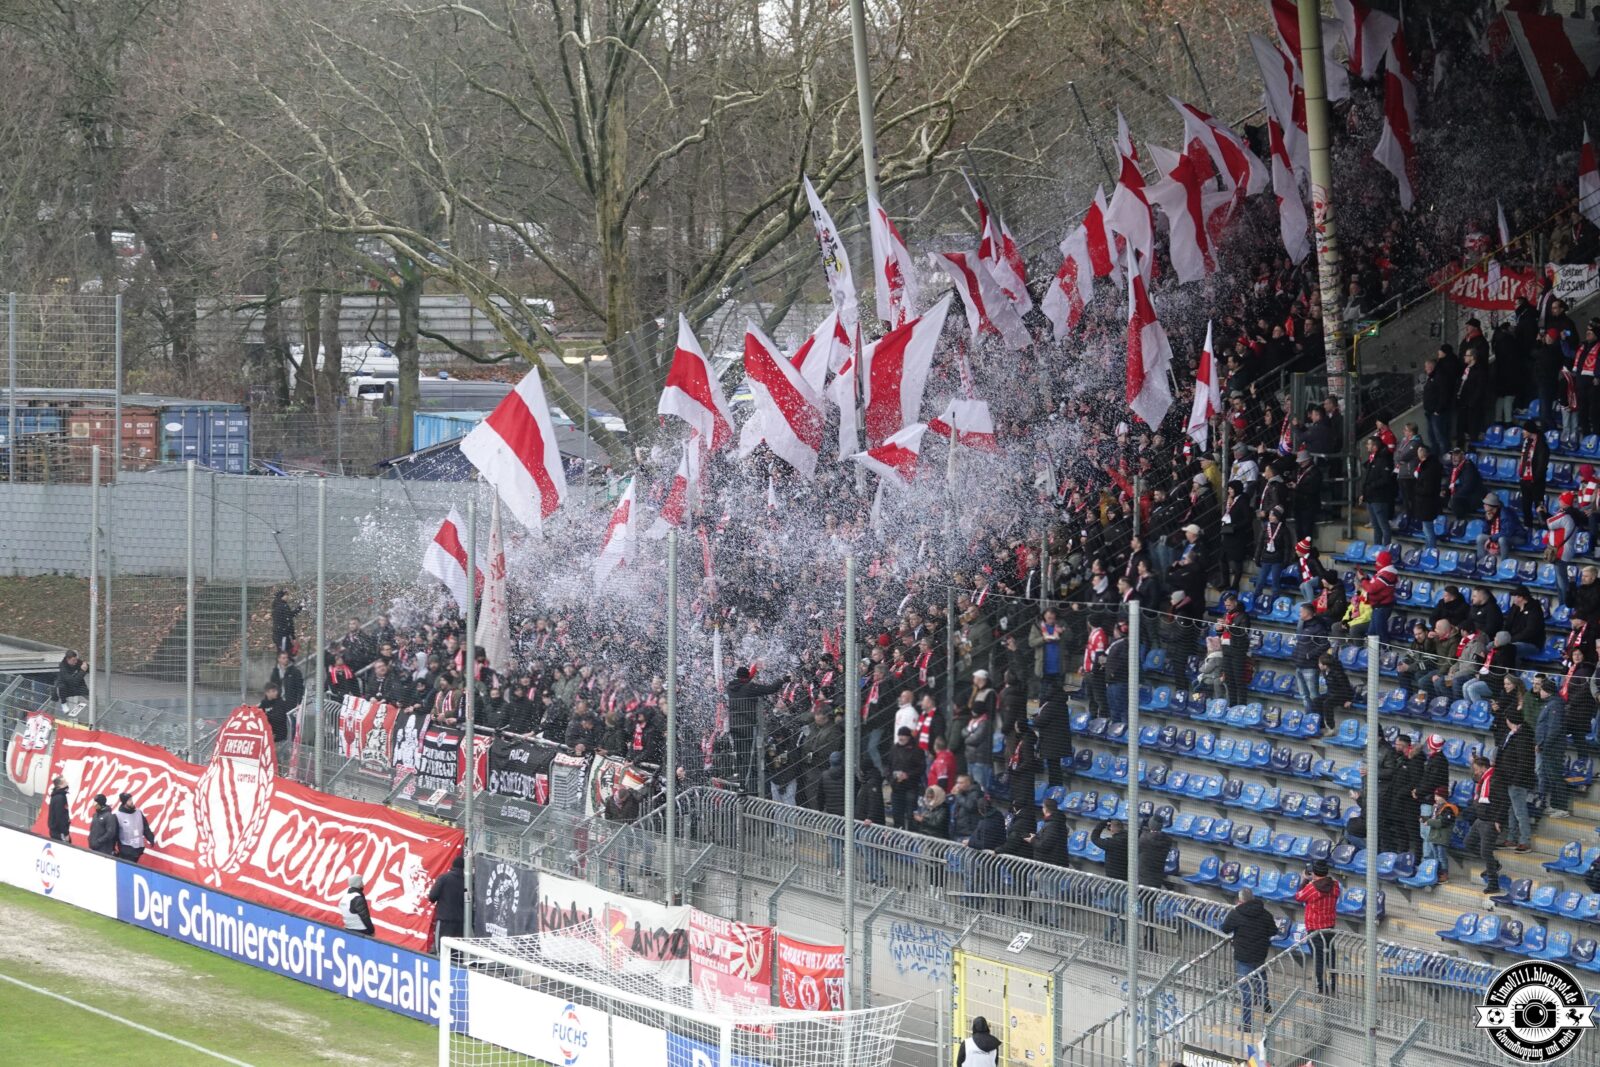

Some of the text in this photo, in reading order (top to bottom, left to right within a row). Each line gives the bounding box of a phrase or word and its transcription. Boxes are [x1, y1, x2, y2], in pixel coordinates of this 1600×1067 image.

[35, 858, 61, 879] FUCHS
[265, 811, 409, 906] COTTBUS
[133, 873, 172, 929] Der
[690, 908, 731, 937] ENERGIE
[1010, 934, 1028, 951] 25
[552, 1023, 588, 1048] FUCHS
